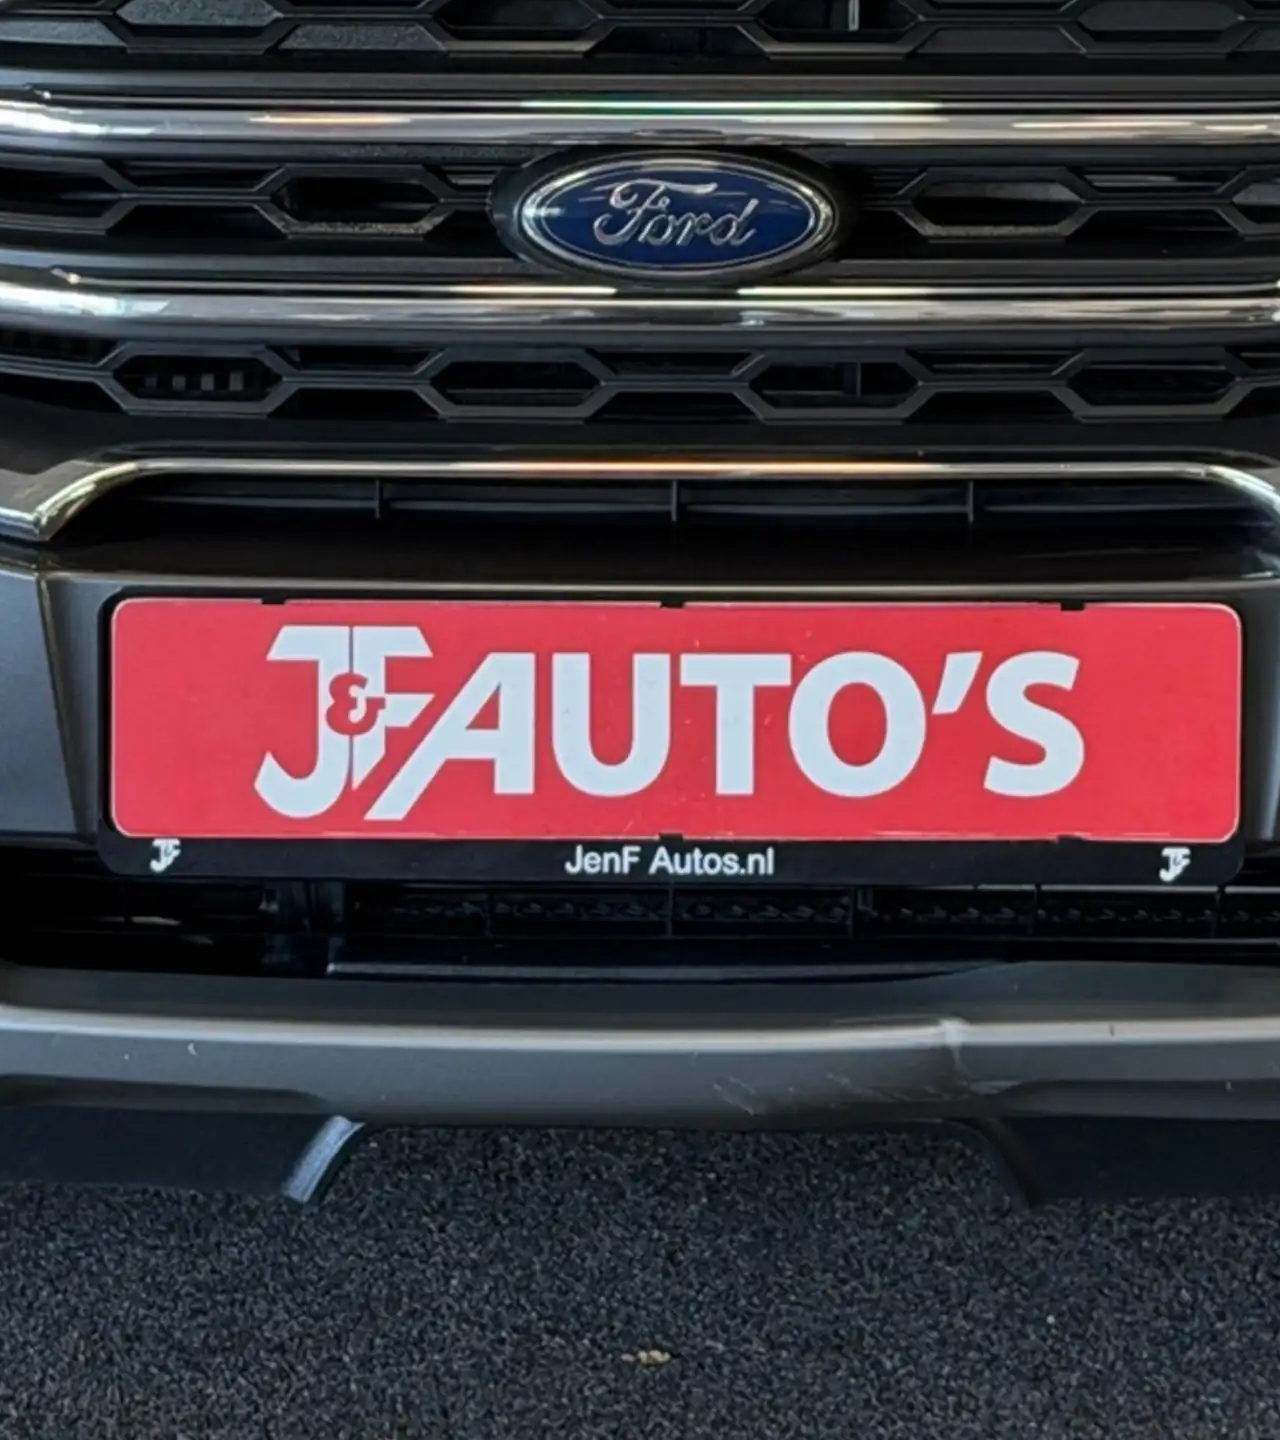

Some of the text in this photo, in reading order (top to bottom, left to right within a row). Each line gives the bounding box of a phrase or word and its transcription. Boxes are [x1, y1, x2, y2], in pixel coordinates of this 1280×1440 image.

[593, 178, 759, 246] Ford
[564, 844, 775, 875] JenF Autos.nl
